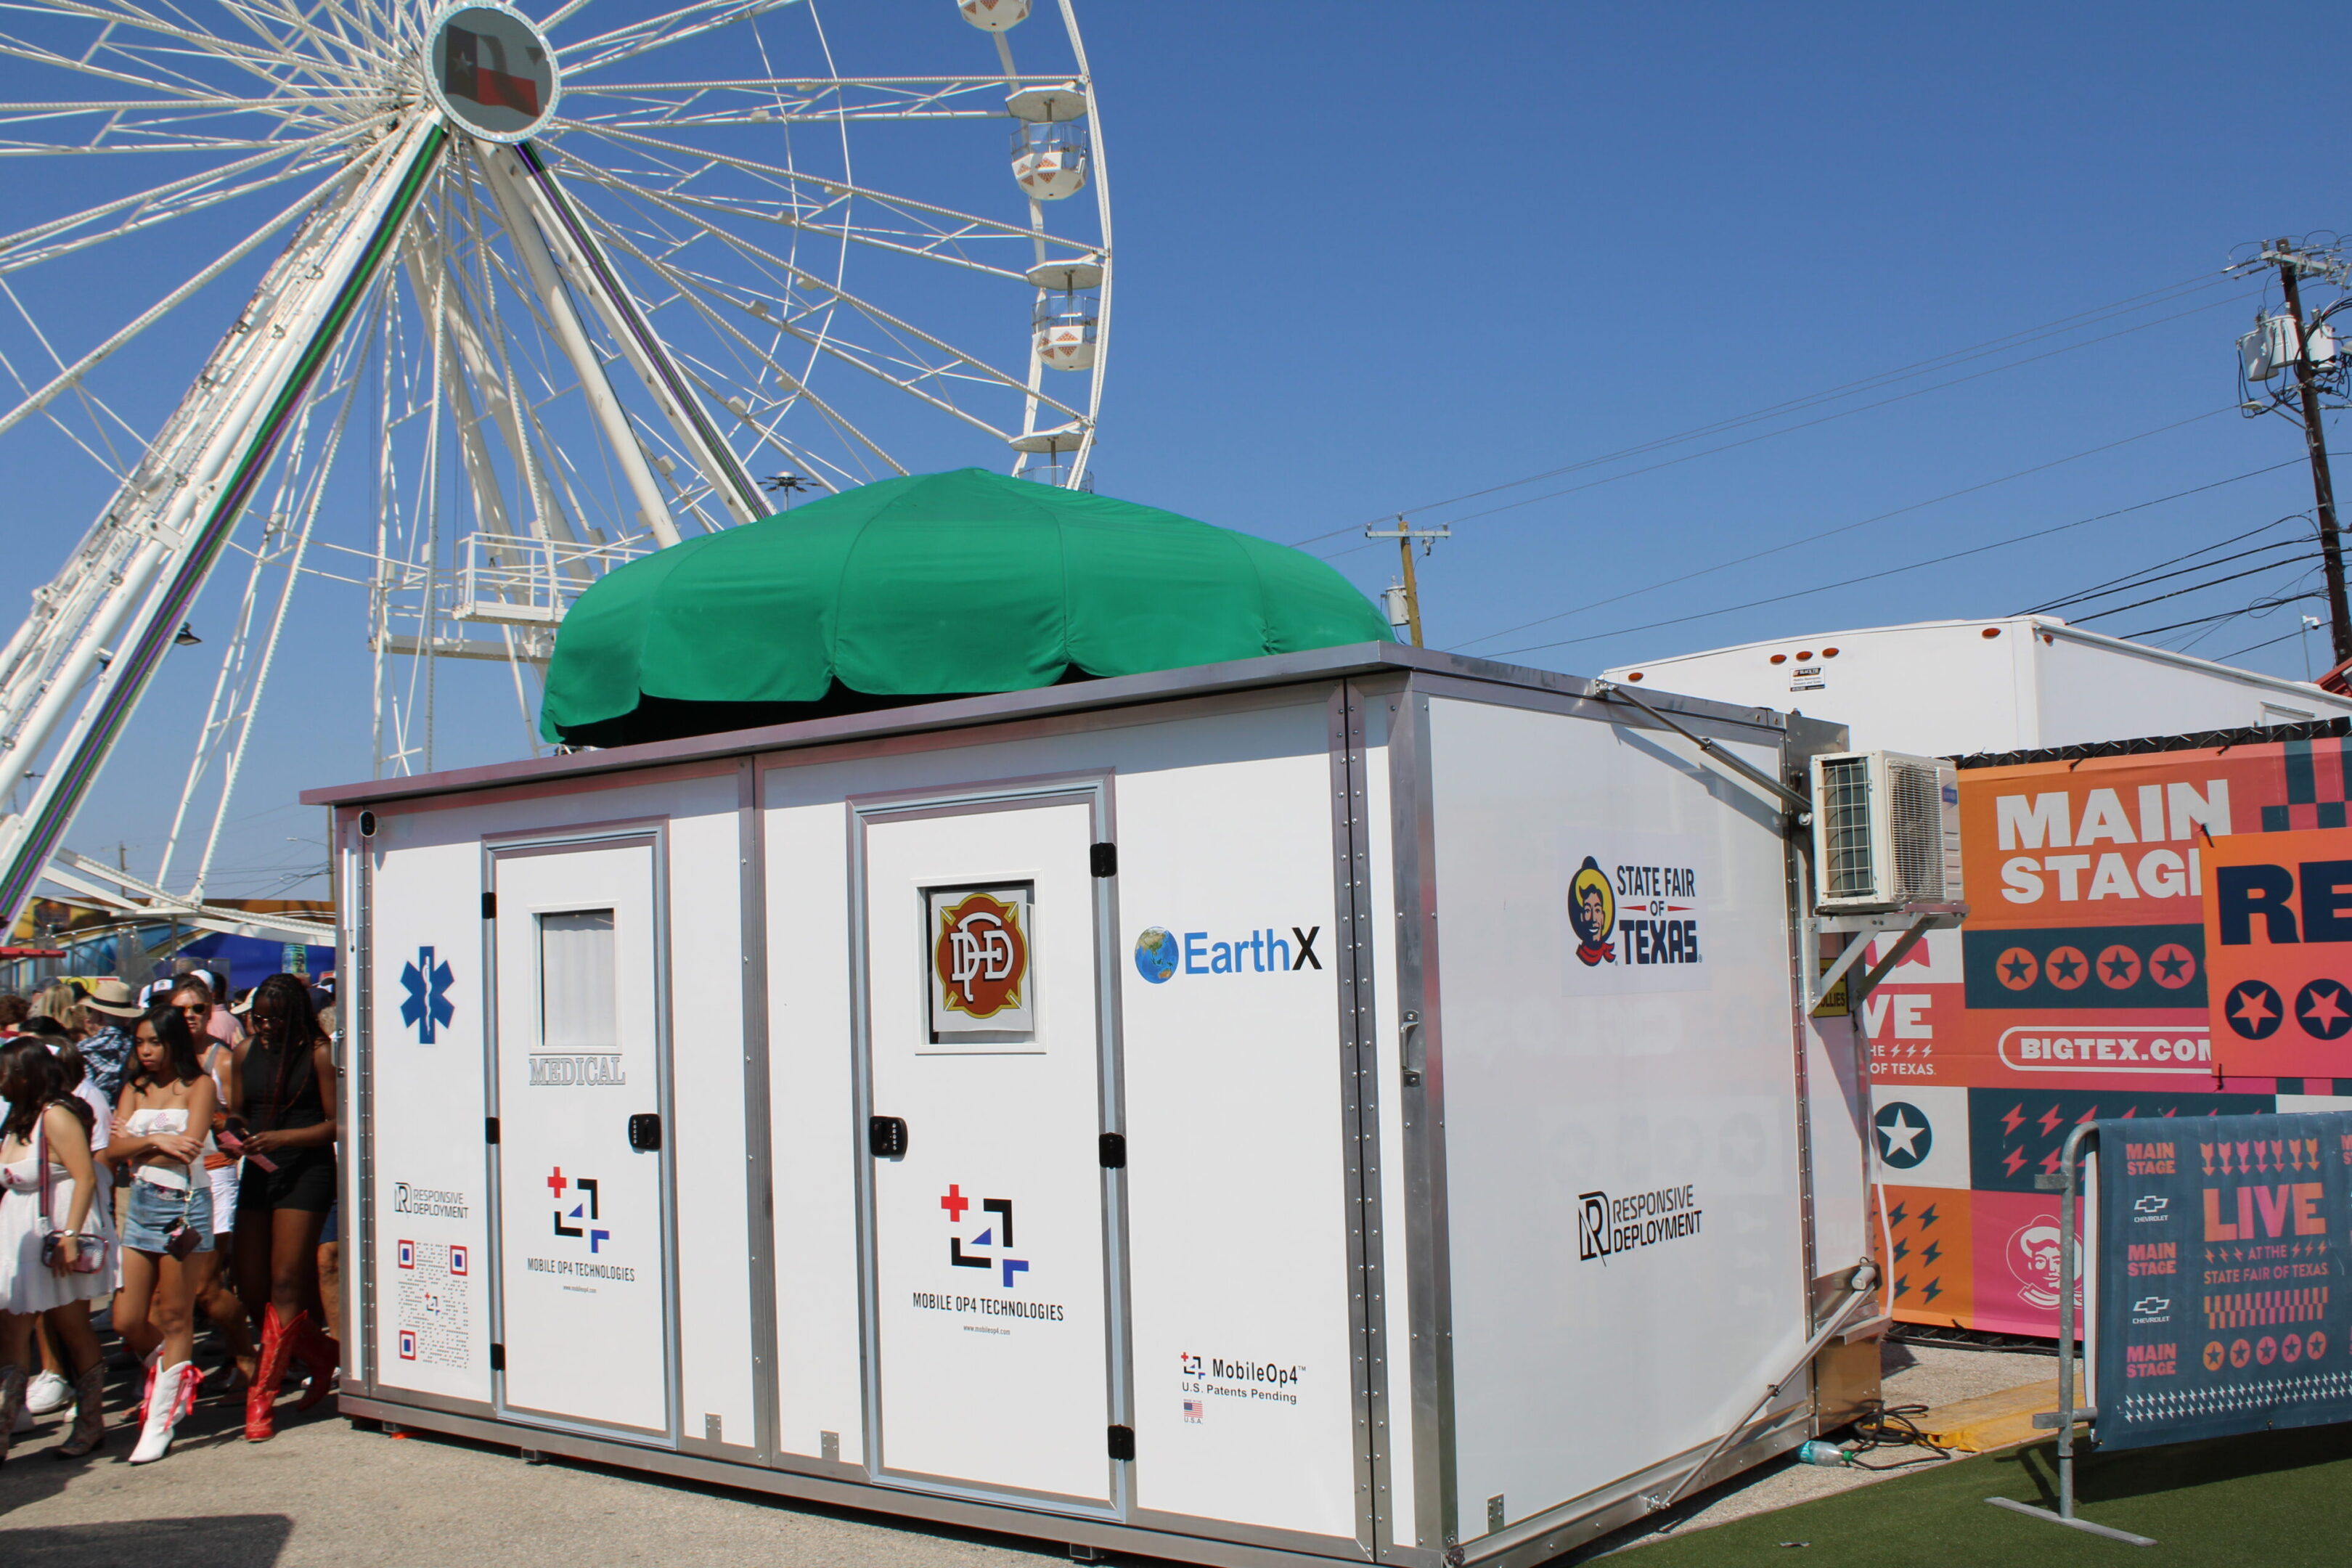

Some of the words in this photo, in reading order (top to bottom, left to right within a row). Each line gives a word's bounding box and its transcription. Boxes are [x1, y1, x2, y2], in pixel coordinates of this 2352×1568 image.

[1996, 779, 2231, 851] MAIN
[1617, 865, 1661, 897] STATE
[1664, 867, 1696, 897] FAIR
[1650, 900, 1665, 916] OF
[1184, 926, 1323, 974] EarthX
[1619, 920, 1697, 965] TEXAS
[1862, 994, 1932, 1039] VE
[1870, 1045, 1885, 1057] HE
[528, 1056, 626, 1086] MEDICAL
[1870, 1063, 1888, 1074] OF
[2126, 1142, 2175, 1160] MAIN
[2127, 1159, 2176, 1176] STAGE
[413, 1188, 464, 1204] RESPONSIVE
[1612, 1184, 1694, 1224] RESPONSIVE
[413, 1202, 469, 1219] DEPLOYMENT
[2202, 1182, 2326, 1242] LIVE
[1614, 1210, 1702, 1253] DEPLOYMENT
[2128, 1242, 2176, 1261] MAIN
[2248, 1246, 2262, 1260] AT
[2264, 1244, 2287, 1259] THE
[527, 1257, 555, 1273] MOBILE
[558, 1261, 573, 1275] OP4
[575, 1262, 635, 1282] TECHNOLOGIES
[2128, 1259, 2176, 1276] STAGE
[2204, 1269, 2240, 1284] STATE
[2243, 1267, 2270, 1281] FAIR
[2273, 1265, 2289, 1279] OF
[913, 1292, 952, 1311] MOBILE
[956, 1297, 977, 1313] OP4
[980, 1298, 1064, 1321] TECHNOLOGIES
[2132, 1315, 2171, 1324] CHEVROLET
[963, 1325, 1010, 1336] www.mobileop4.com
[2126, 1343, 2176, 1363] MAIN
[2126, 1361, 2176, 1378] STAGE
[1182, 1381, 1204, 1393] U.S.
[1206, 1384, 1247, 1398] Patents
[1251, 1389, 1297, 1405] Pending
